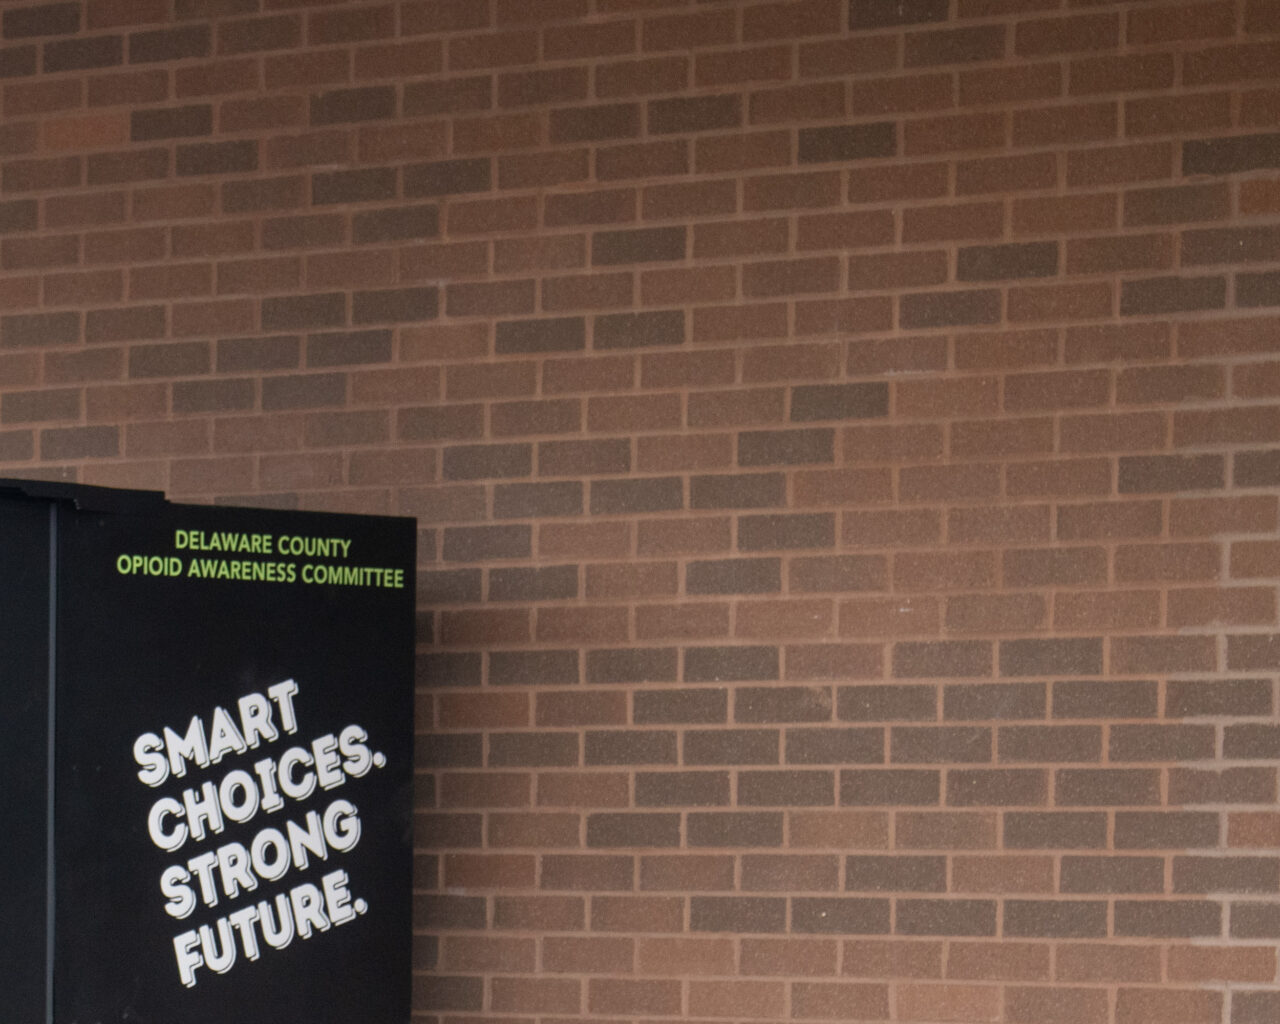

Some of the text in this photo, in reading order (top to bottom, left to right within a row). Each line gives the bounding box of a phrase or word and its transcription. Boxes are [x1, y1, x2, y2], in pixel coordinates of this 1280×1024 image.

[116, 554, 404, 588] OPIOID AWARENESS COMMITTEE
[175, 530, 352, 558] DELAWARE COUNTY
[133, 678, 299, 787] SMART
[148, 724, 387, 853] CHOICES.
[159, 799, 362, 920] STRONG
[173, 868, 369, 988] FUTURE.
